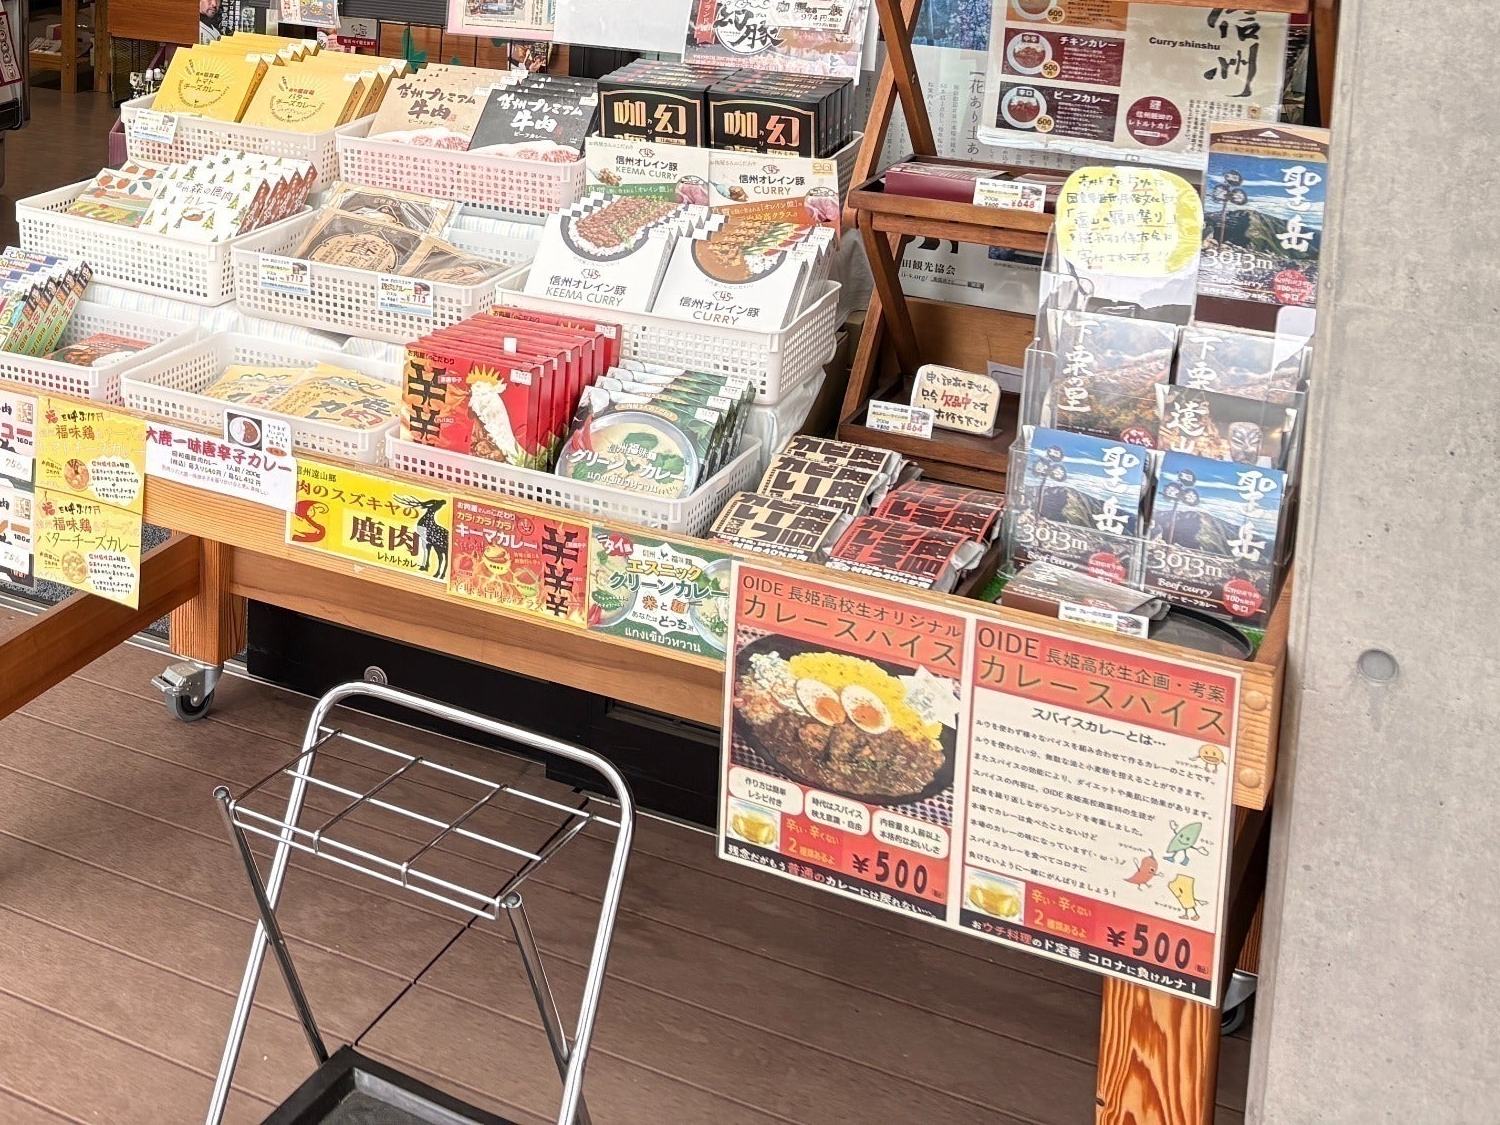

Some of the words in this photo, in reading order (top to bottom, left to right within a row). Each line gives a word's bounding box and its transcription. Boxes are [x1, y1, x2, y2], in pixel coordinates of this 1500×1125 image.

[1048, 10, 1063, 18] 600
[1059, 36, 1117, 48] チキンカレー
[1149, 37, 1177, 48] Curry
[1179, 40, 1220, 51] shinshu
[1203, 8, 1261, 97] 信州
[1043, 63, 1058, 71] 600
[182, 83, 222, 94] チーズカレー
[288, 93, 309, 101] バター
[396, 83, 477, 105] 信州プレミアム
[1054, 90, 1110, 104] ビーフカレー
[408, 100, 452, 120] 牛肉
[496, 93, 583, 116] 信州プレミアム
[509, 111, 559, 134] 牛肉
[1037, 118, 1052, 126] 600
[1128, 119, 1179, 130] レトルトカレー
[615, 155, 678, 172] 信州オレイン豚
[615, 166, 647, 177] KEEMA
[649, 169, 678, 180] CURRY
[738, 174, 806, 186] 信州オレイン豚
[754, 186, 791, 196] CURRY
[184, 194, 218, 206] カレー
[1276, 165, 1322, 252] 聖岳
[1205, 249, 1273, 272] 3013m
[549, 274, 627, 296] 信州オレイン豚
[545, 286, 583, 302] KEEMA
[586, 292, 624, 307] CURRY
[679, 295, 760, 319] 信州オレイン豚
[693, 312, 739, 325] CURRY
[146, 426, 292, 472] 大鹿一味唐辛子カレー
[570, 449, 625, 470] グリーン
[640, 464, 686, 481] カレー
[1227, 470, 1278, 562] 聖岳
[38, 533, 140, 553] バターチーズカレー
[350, 516, 420, 557] 鹿肉
[454, 523, 538, 549] キーマカレー
[1017, 525, 1089, 551] 3013m
[377, 551, 427, 570] レトルトカレー
[626, 559, 703, 581] エスニック
[1151, 549, 1223, 578] 3013m
[609, 571, 729, 599] グリーンカレー
[743, 575, 784, 597] OIDE
[788, 587, 962, 638] 長姫高校生オリジナル
[625, 628, 701, 652] แกงเขียวหวาน
[743, 595, 957, 667] カレースパイス
[978, 627, 1040, 659] OIDE
[1046, 649, 1226, 703] 長姫高校生企画・考案
[980, 655, 1226, 736] カレースパイス
[745, 777, 787, 796] 作り方は簡単
[748, 790, 783, 807] レシピ付き
[812, 797, 863, 819] 時代はスパイス
[880, 830, 941, 855] 本格的なおいしさ
[852, 850, 928, 894] ¥500
[972, 920, 1082, 960] おウチ料理のド定番
[1106, 923, 1191, 970] ¥500
